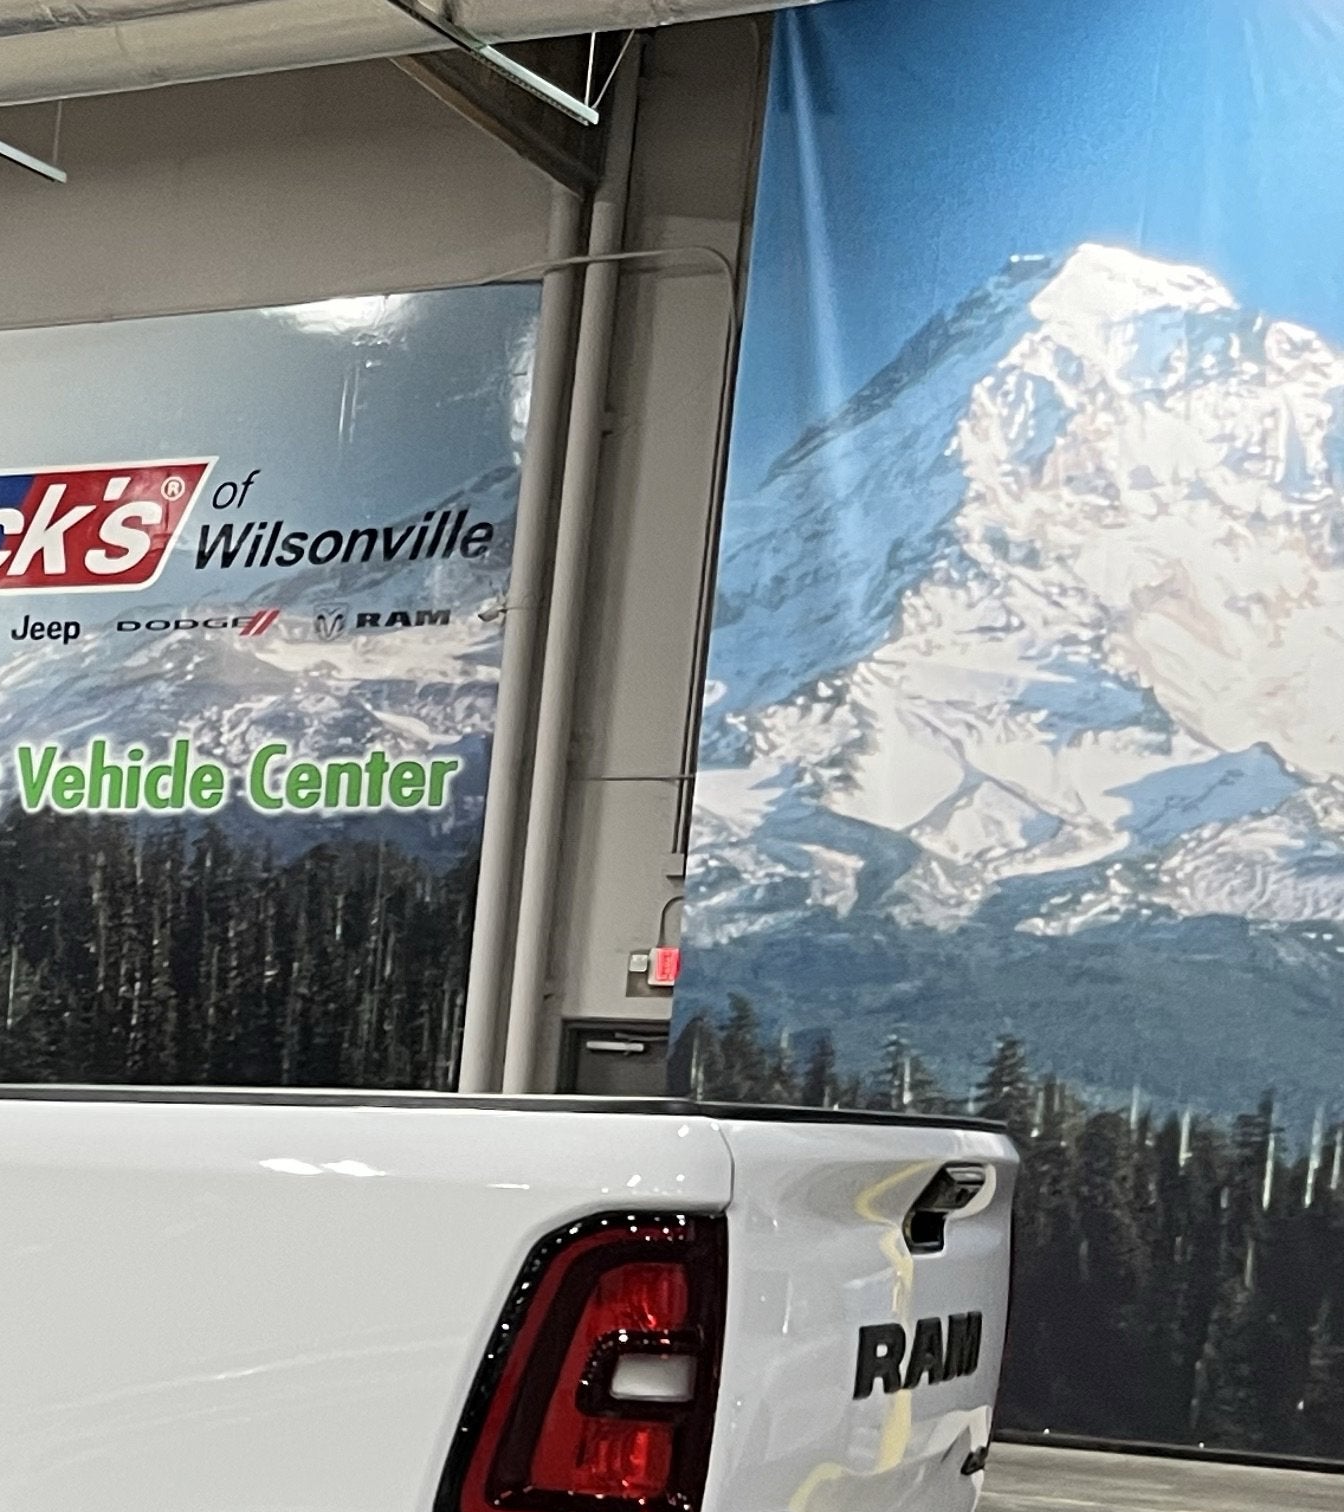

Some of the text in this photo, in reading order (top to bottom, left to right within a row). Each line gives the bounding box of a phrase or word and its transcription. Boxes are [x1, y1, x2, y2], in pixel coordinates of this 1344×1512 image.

[212, 469, 261, 509] of
[194, 506, 494, 570] Wilsonville
[10, 614, 80, 645] Jeep
[116, 615, 252, 633] DODGE
[355, 609, 451, 628] RAM
[18, 740, 224, 810] Vehicle
[250, 743, 459, 810] Center
[852, 1310, 983, 1401] RAM
